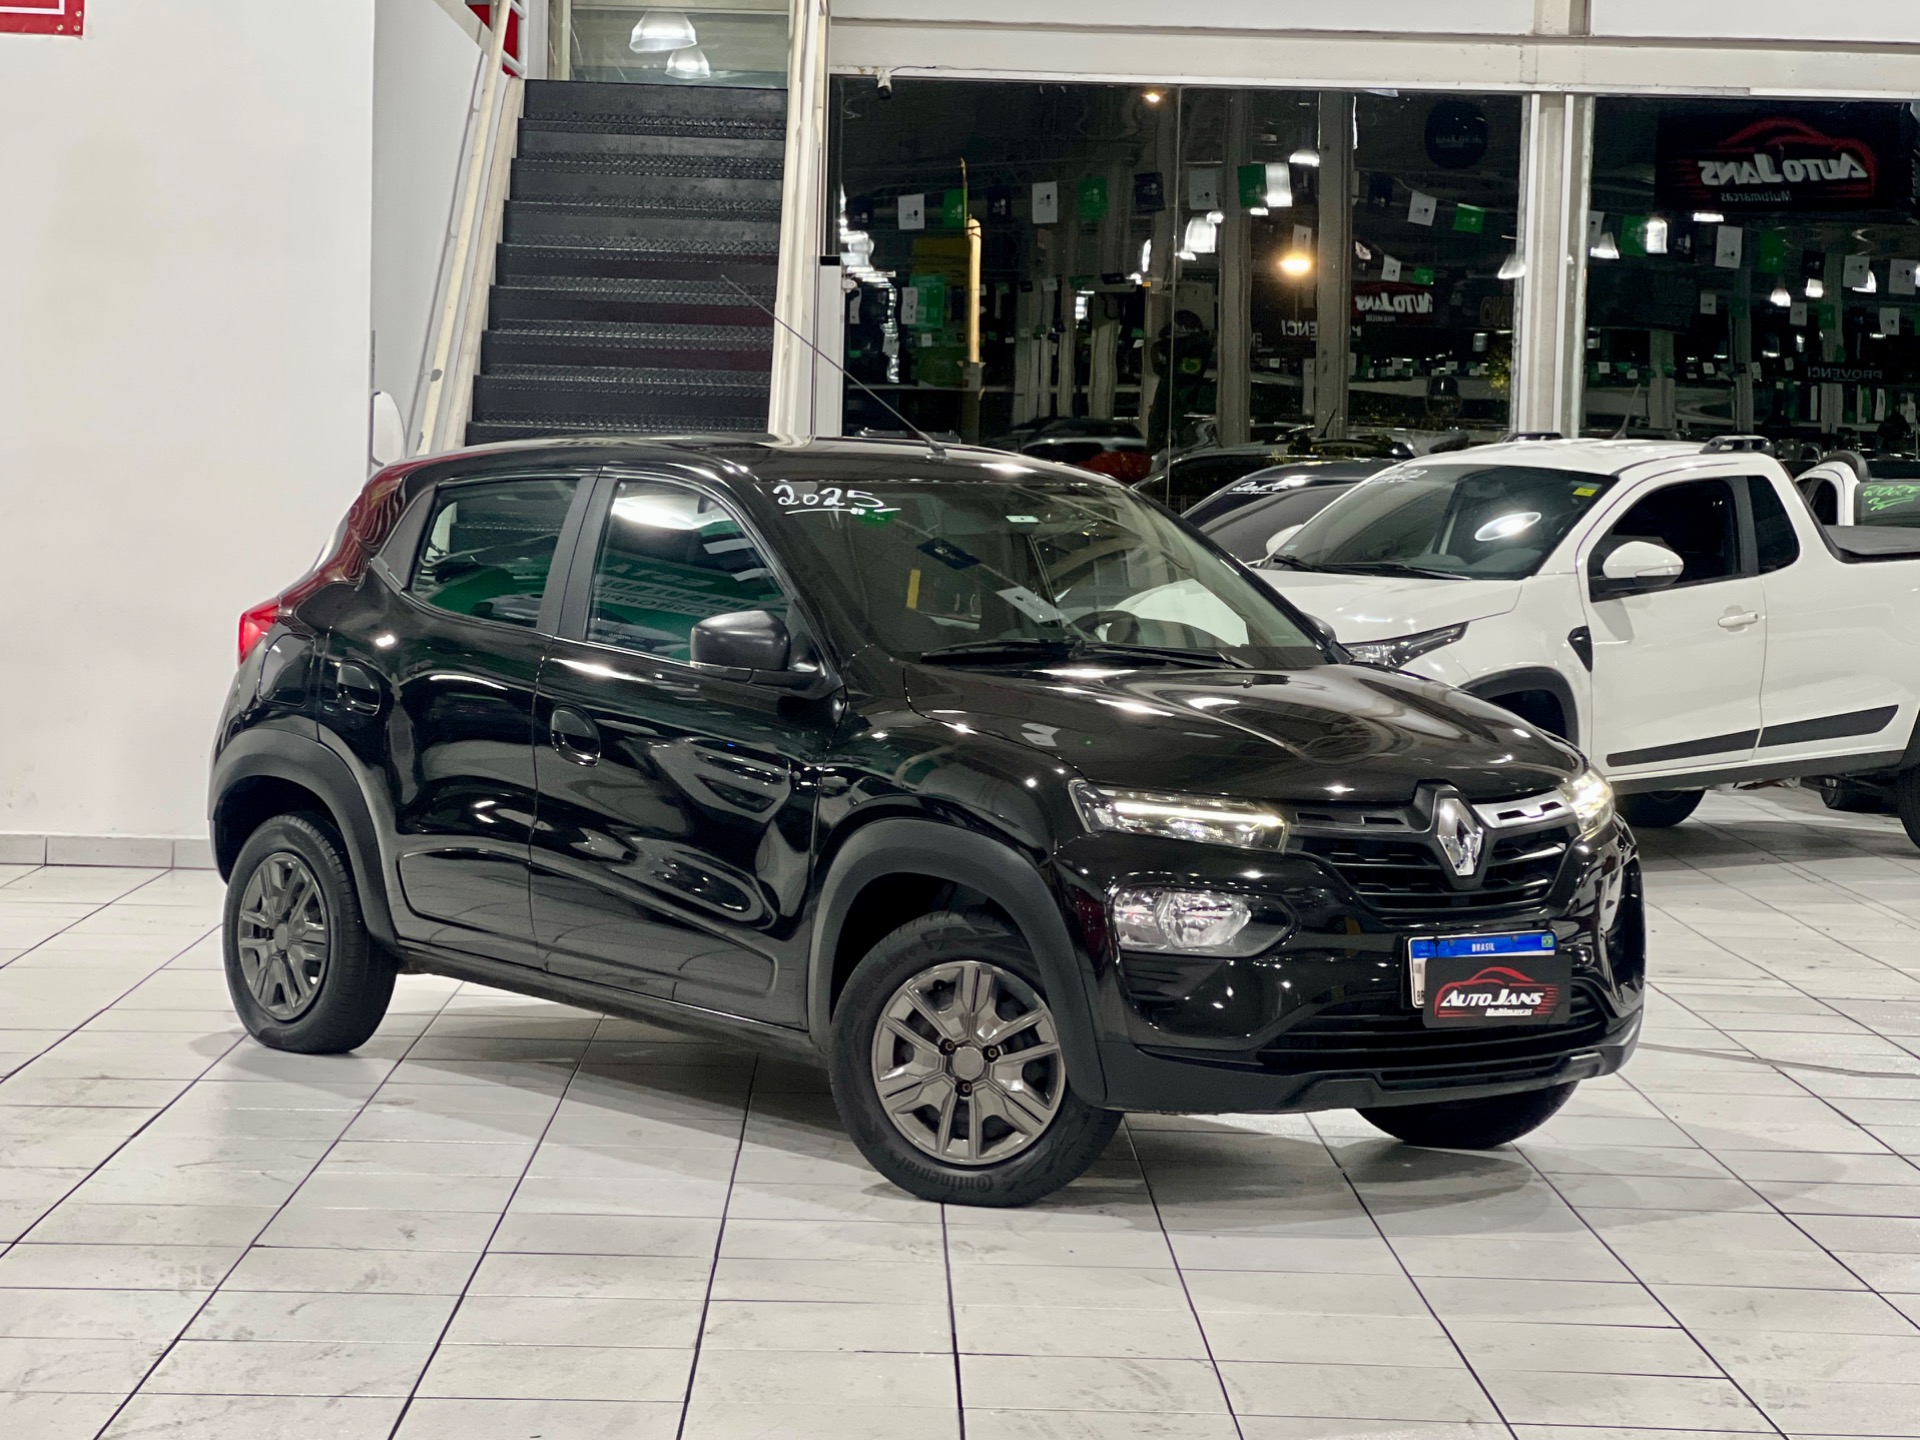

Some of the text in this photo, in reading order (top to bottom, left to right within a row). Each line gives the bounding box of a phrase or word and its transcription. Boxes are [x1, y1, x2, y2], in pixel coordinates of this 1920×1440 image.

[773, 484, 887, 509] 2025
[1471, 942, 1495, 953] BRASIL
[1440, 989, 1544, 1007] AUTO JANS
